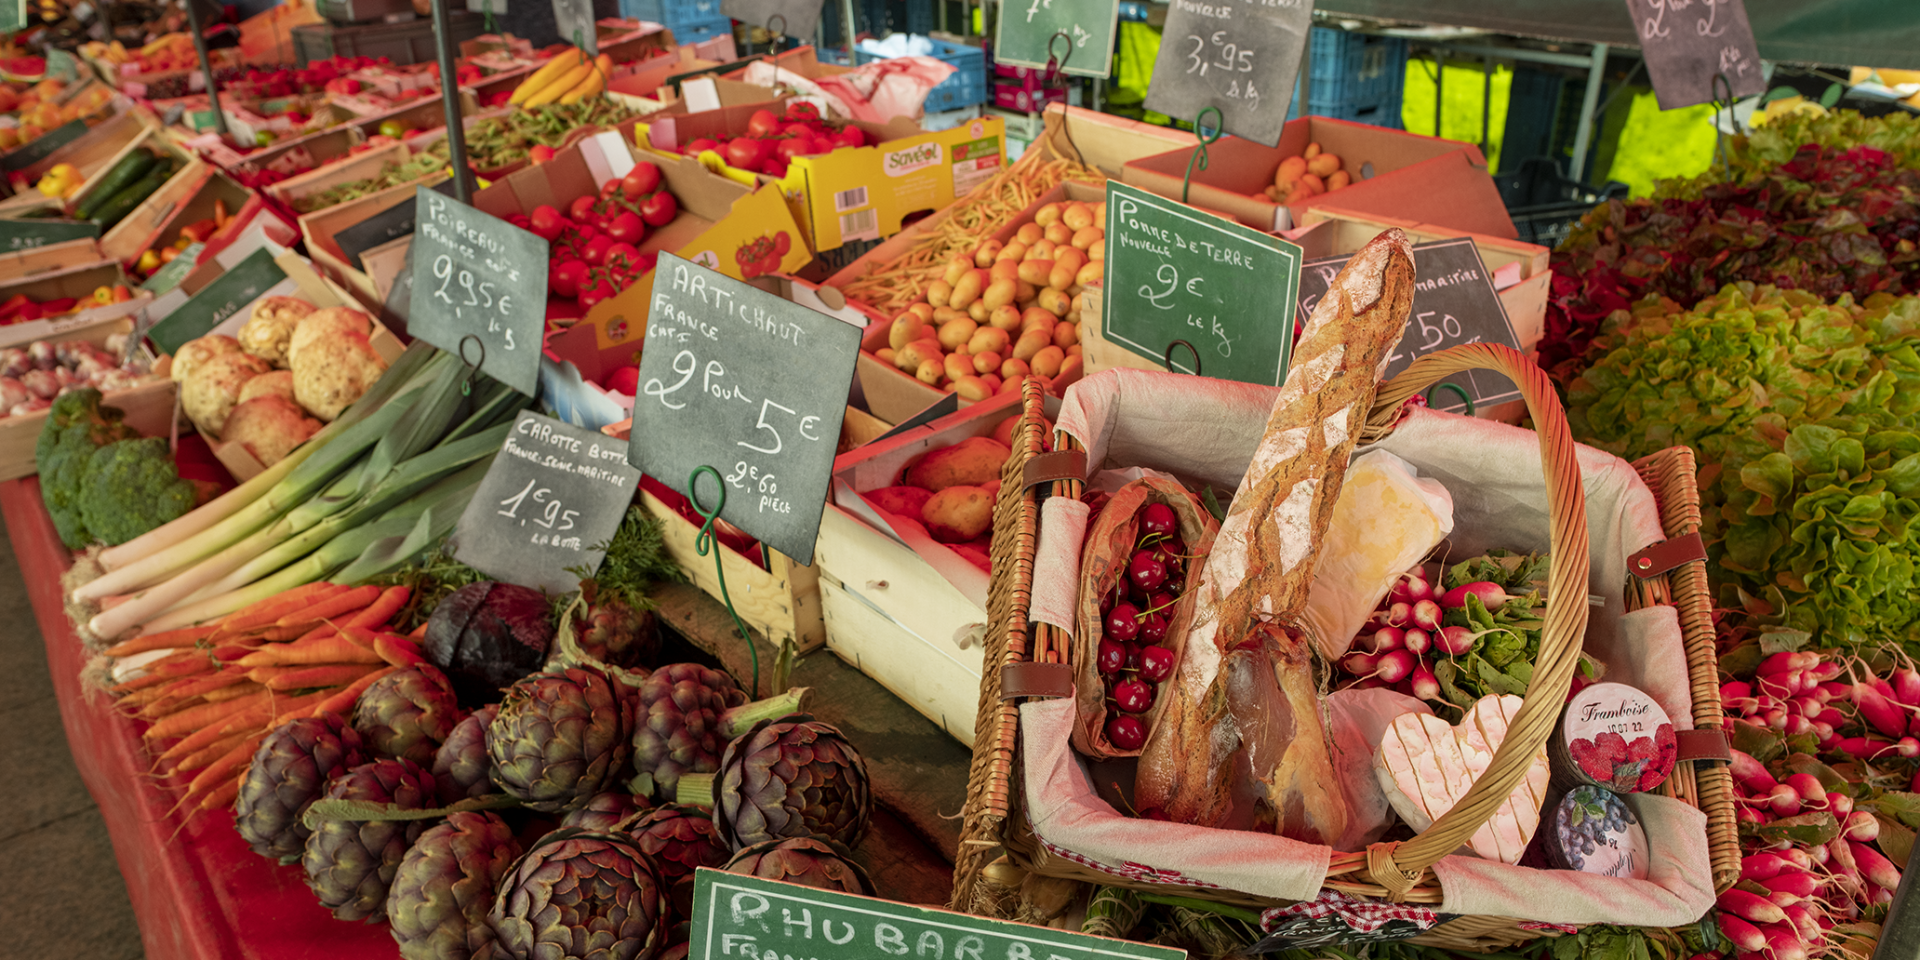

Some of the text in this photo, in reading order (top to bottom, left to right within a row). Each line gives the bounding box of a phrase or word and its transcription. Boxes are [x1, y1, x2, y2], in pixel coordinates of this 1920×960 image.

[889, 143, 938, 169] Savéol
[1120, 231, 1172, 258] NOUVELLE
[1200, 241, 1254, 270] TERRE
[654, 292, 719, 341] FRANCE
[673, 265, 806, 346] ARTICHAUT
[644, 350, 696, 410] 2
[517, 418, 630, 466] CAROTTE BOTTE
[1581, 699, 1650, 722] Framboise
[730, 892, 1073, 960] RHUBARB
